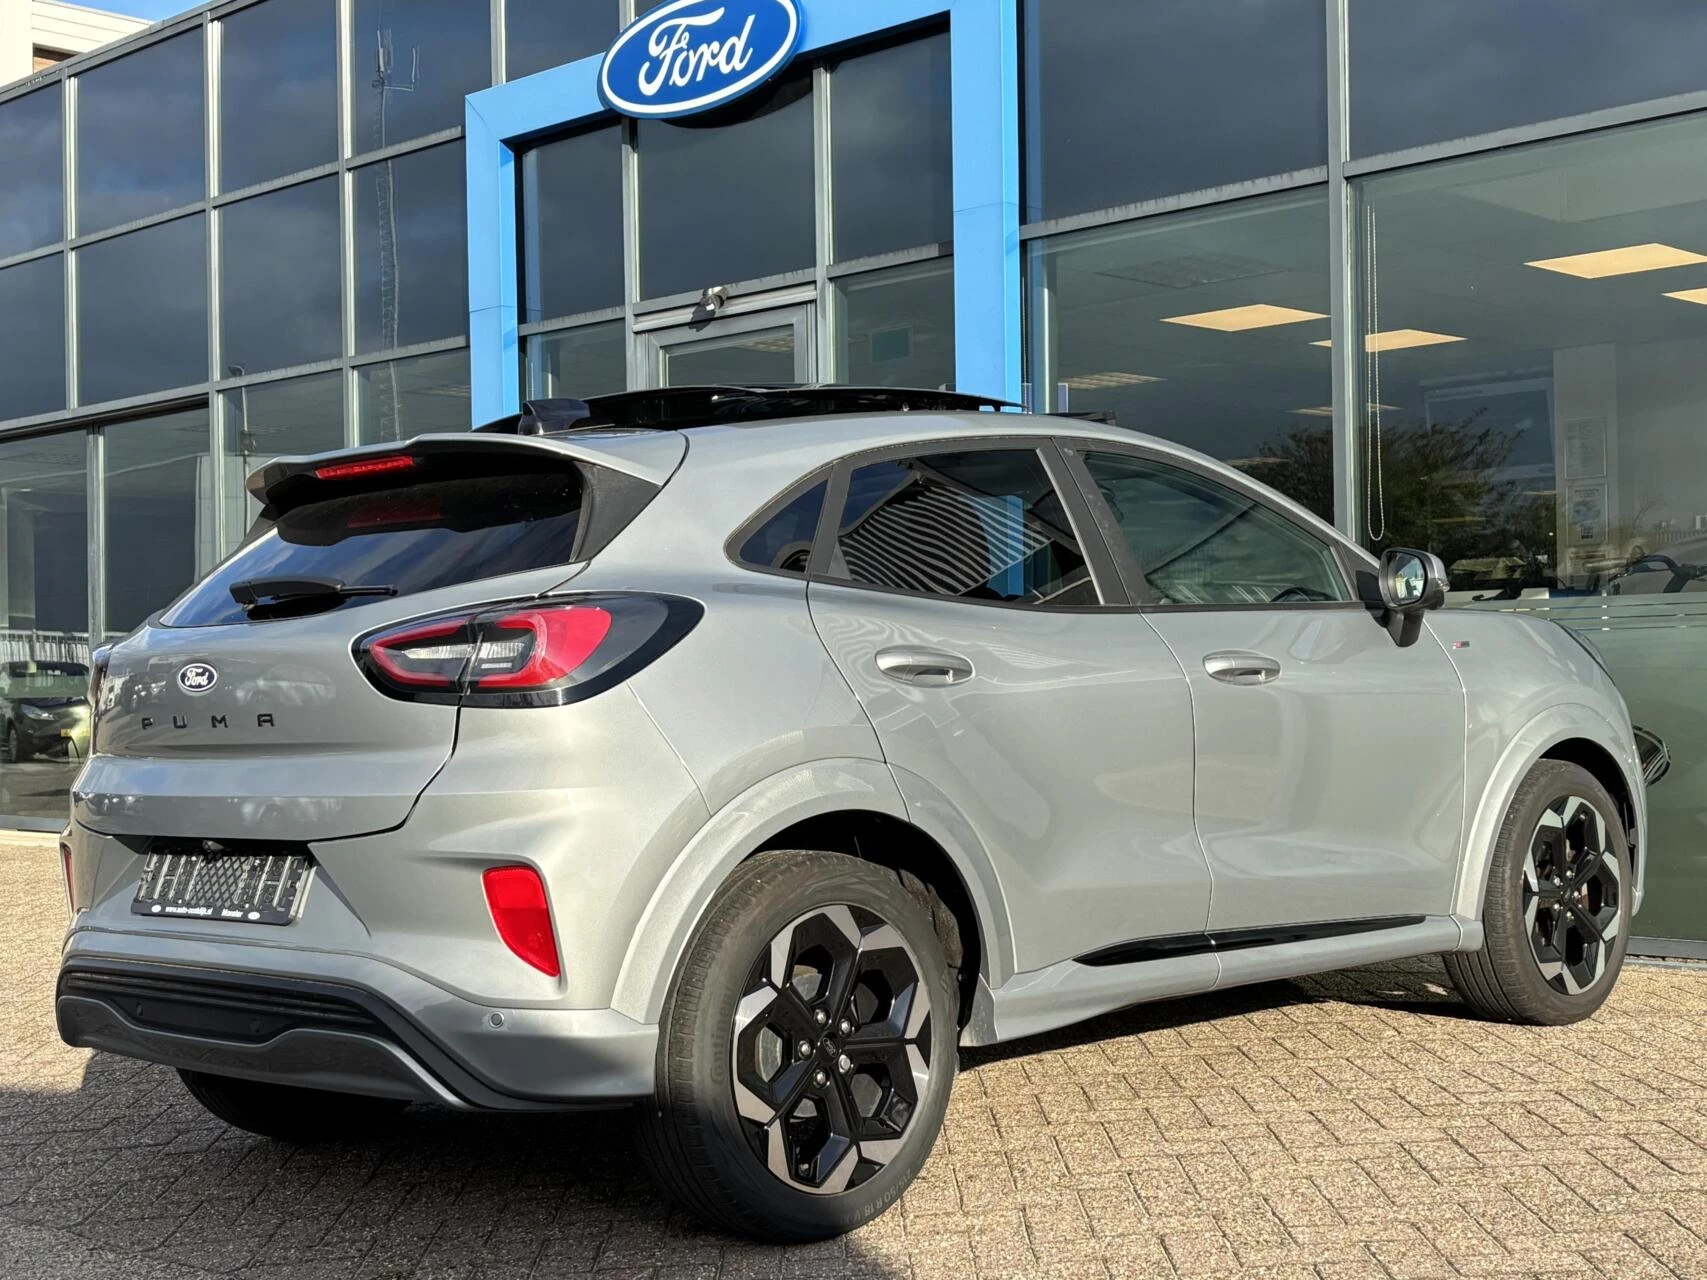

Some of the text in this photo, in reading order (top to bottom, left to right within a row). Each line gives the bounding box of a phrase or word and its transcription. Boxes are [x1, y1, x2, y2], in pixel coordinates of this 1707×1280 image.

[638, 7, 756, 96] Ford
[184, 667, 209, 687] Ford
[141, 713, 275, 730] PUMA
